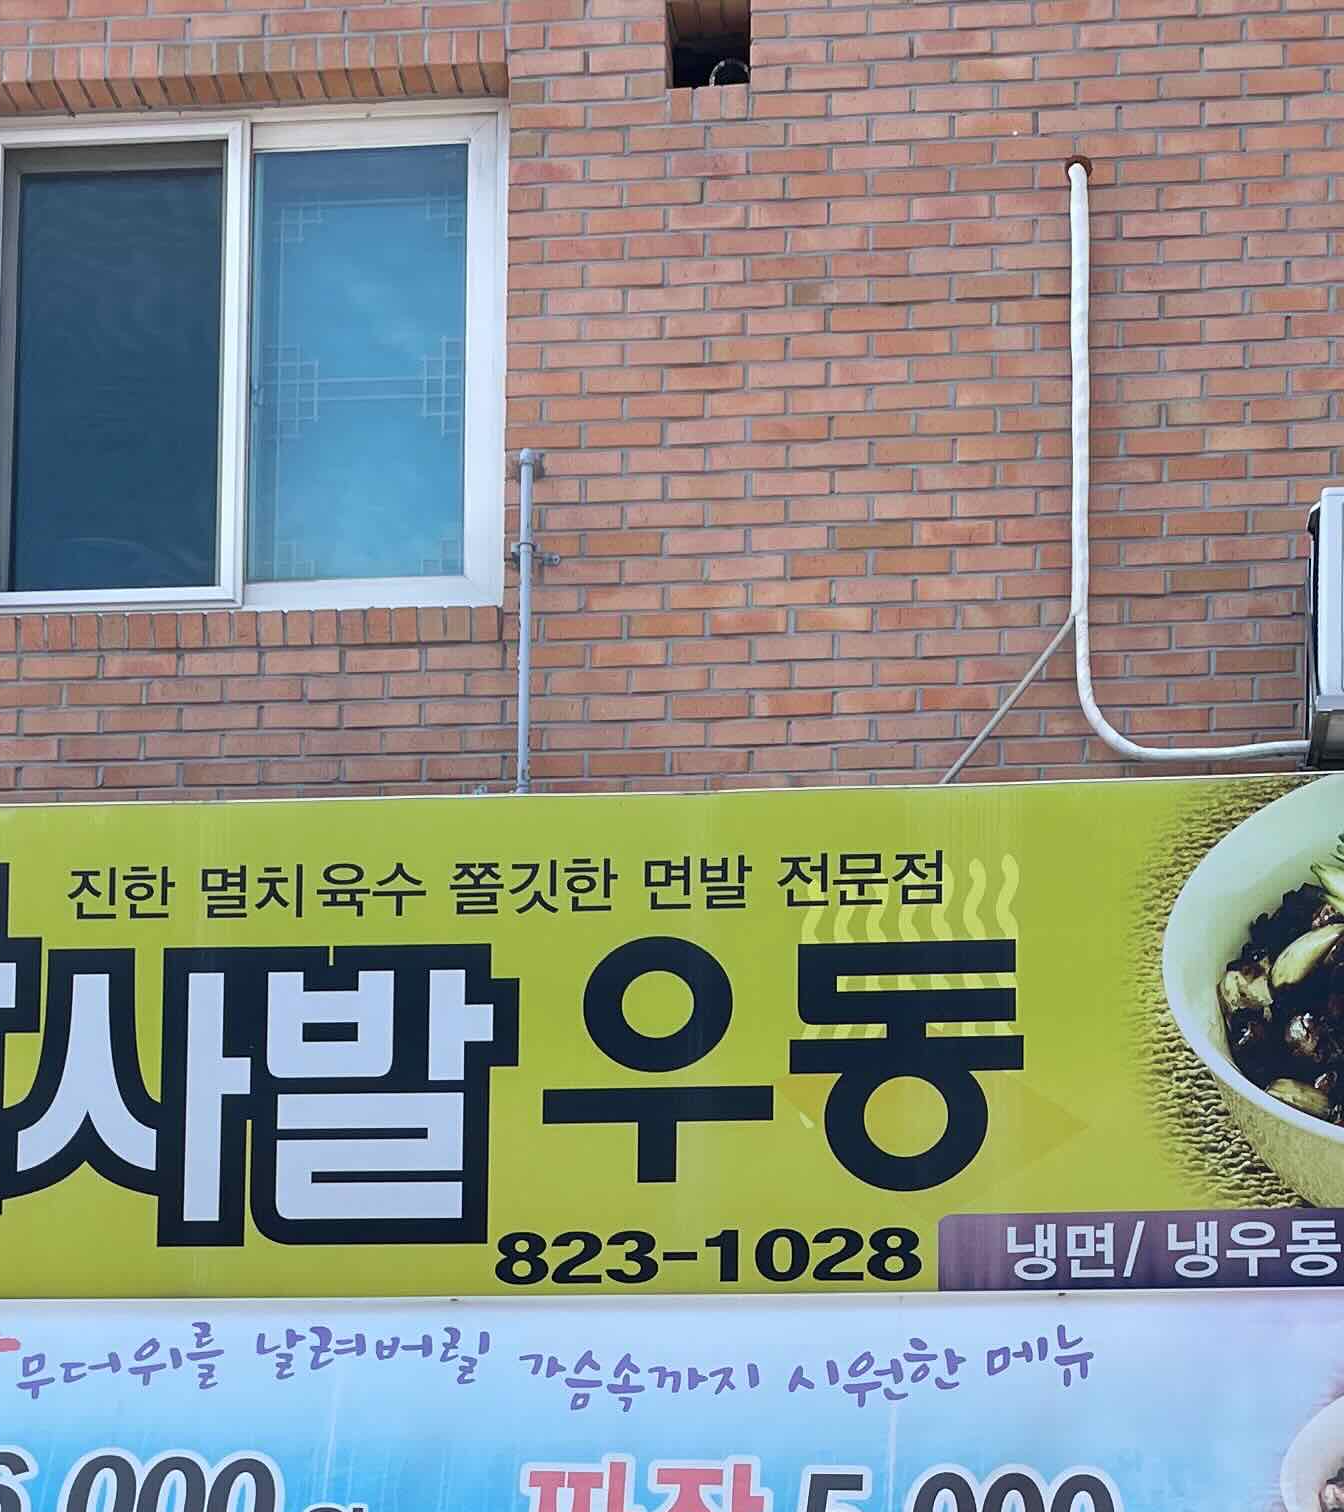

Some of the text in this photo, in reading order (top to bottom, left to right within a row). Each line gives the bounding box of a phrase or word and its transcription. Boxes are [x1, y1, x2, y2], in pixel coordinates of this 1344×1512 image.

[67, 849, 946, 920] 진한 멸치육수 쫄깃한 면발 전문점
[494, 1226, 923, 1286] 823-1028
[1005, 1217, 1142, 1282] 냉면/
[15, 1322, 225, 1400] 무더위를
[256, 1325, 490, 1385] 날려버릴
[519, 1347, 760, 1413] 가슴속까지
[788, 1338, 967, 1408] 시원한
[987, 1324, 1095, 1389] 메뉴
